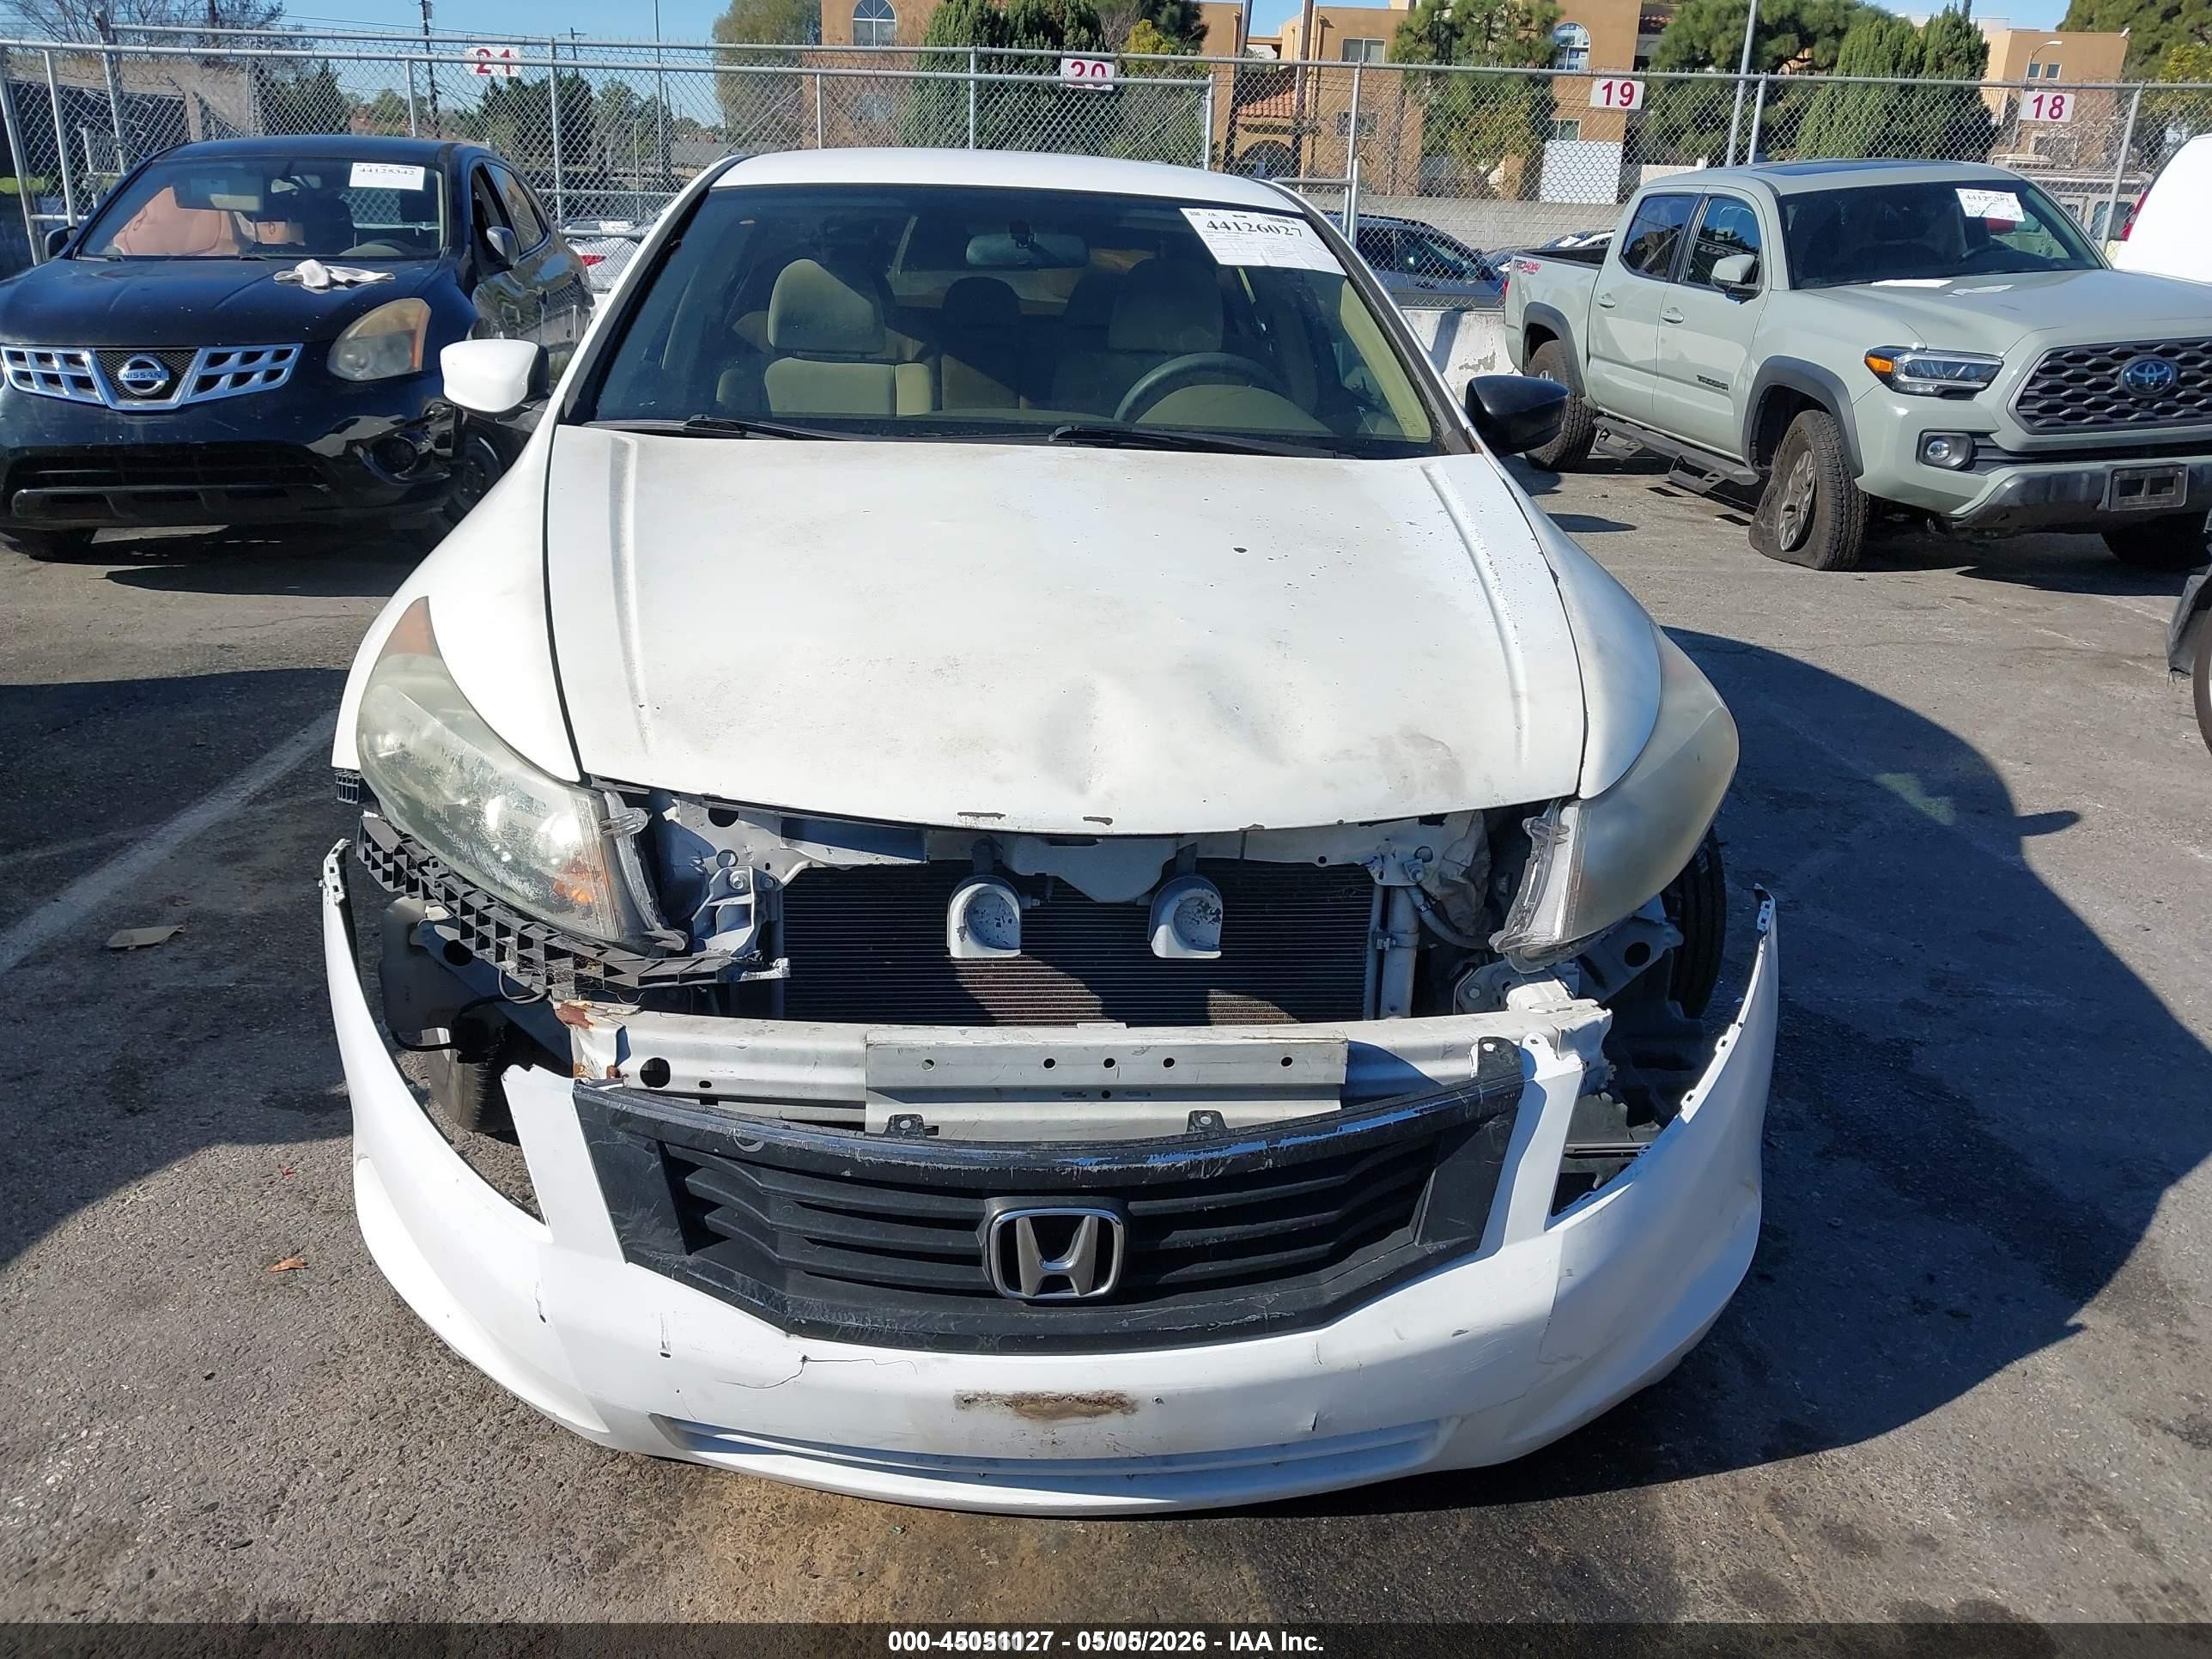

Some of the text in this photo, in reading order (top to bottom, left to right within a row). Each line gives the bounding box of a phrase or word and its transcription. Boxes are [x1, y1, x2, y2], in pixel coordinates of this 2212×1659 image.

[476, 48, 511, 75] 21
[1070, 61, 1108, 88] 20
[1601, 81, 1635, 107] 19
[2033, 94, 2065, 120] 18
[1206, 220, 1304, 239] 44126027
[123, 370, 162, 380] NISSAN
